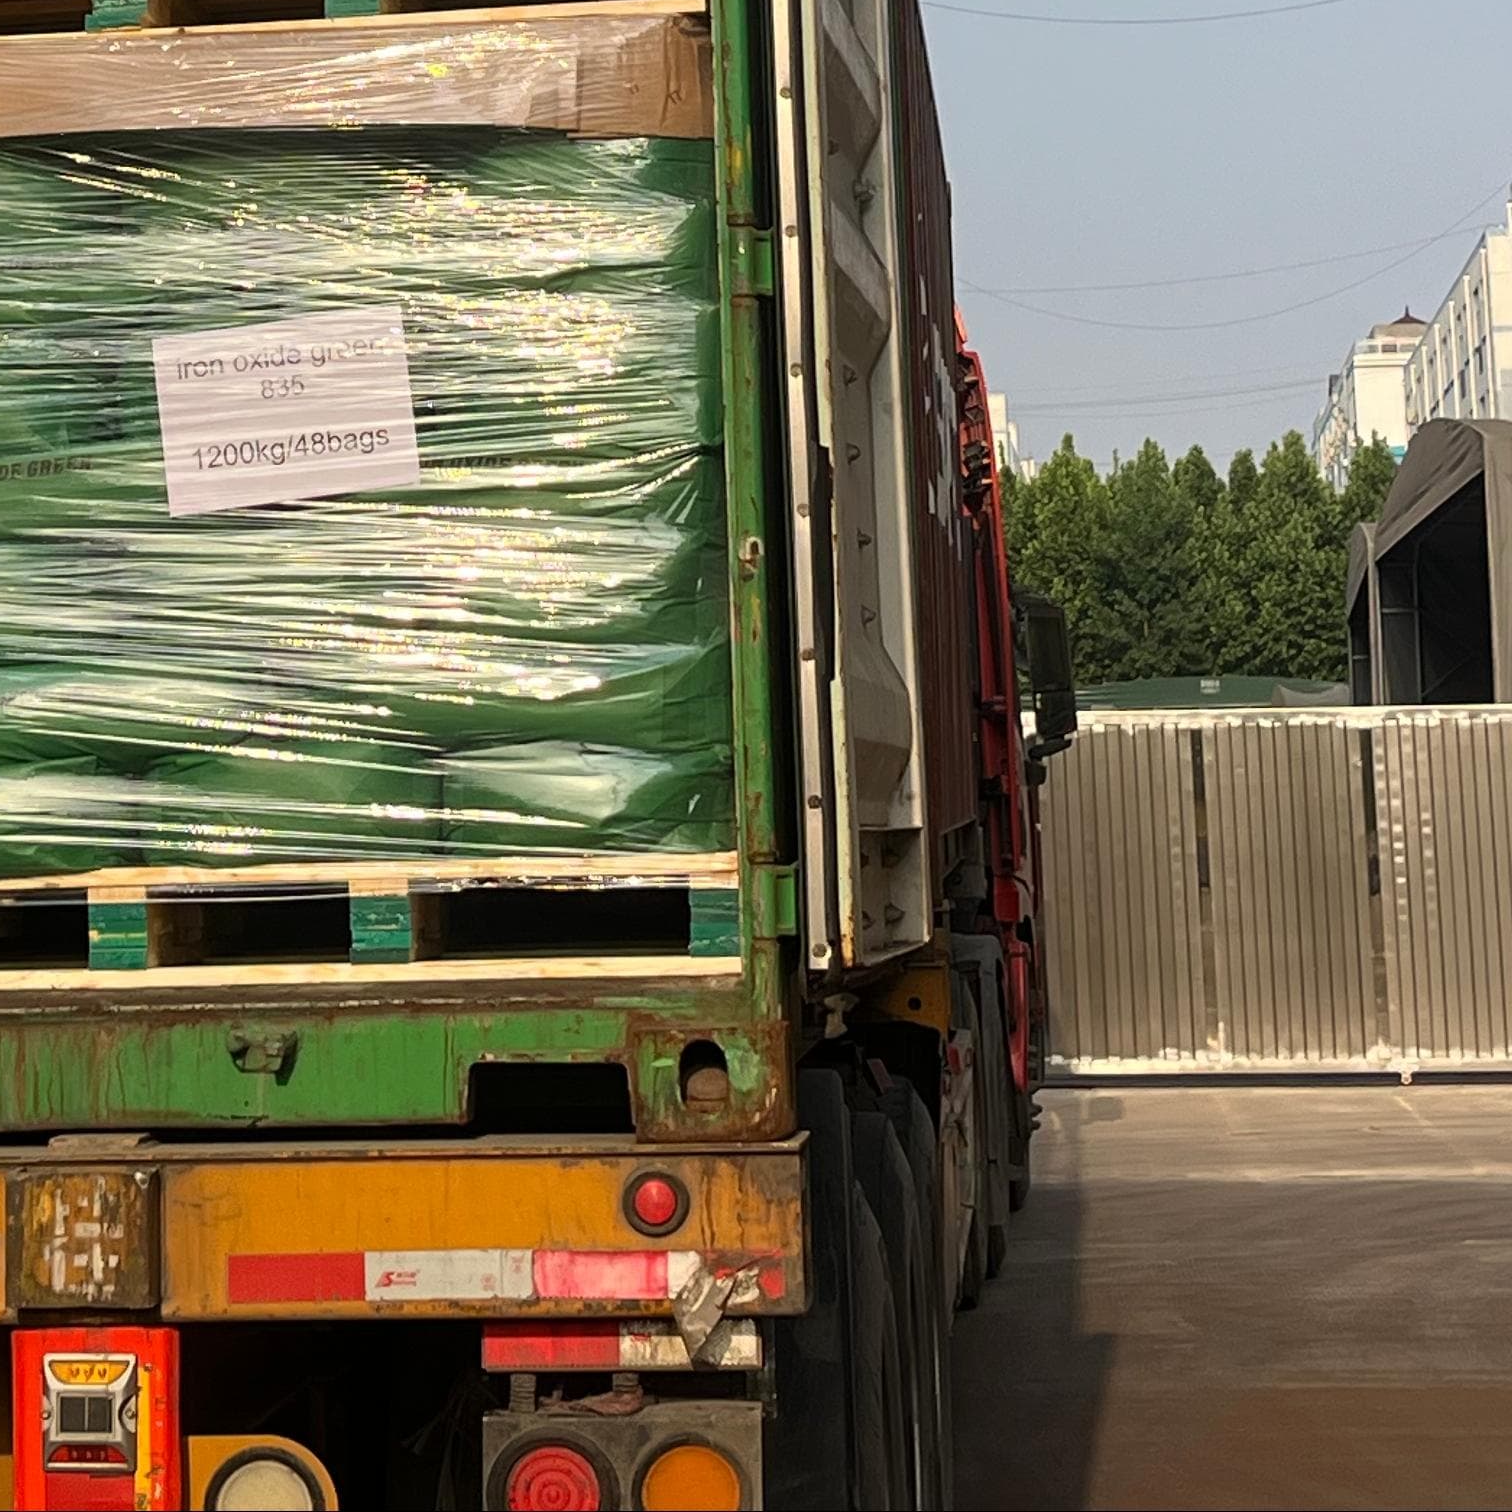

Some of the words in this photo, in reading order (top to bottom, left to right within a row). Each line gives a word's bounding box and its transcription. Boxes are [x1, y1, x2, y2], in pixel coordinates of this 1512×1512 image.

[177, 358, 225, 381] iron
[233, 345, 302, 373] oxide
[261, 375, 306, 400] 835
[191, 427, 390, 471] 1200kg/48bags
